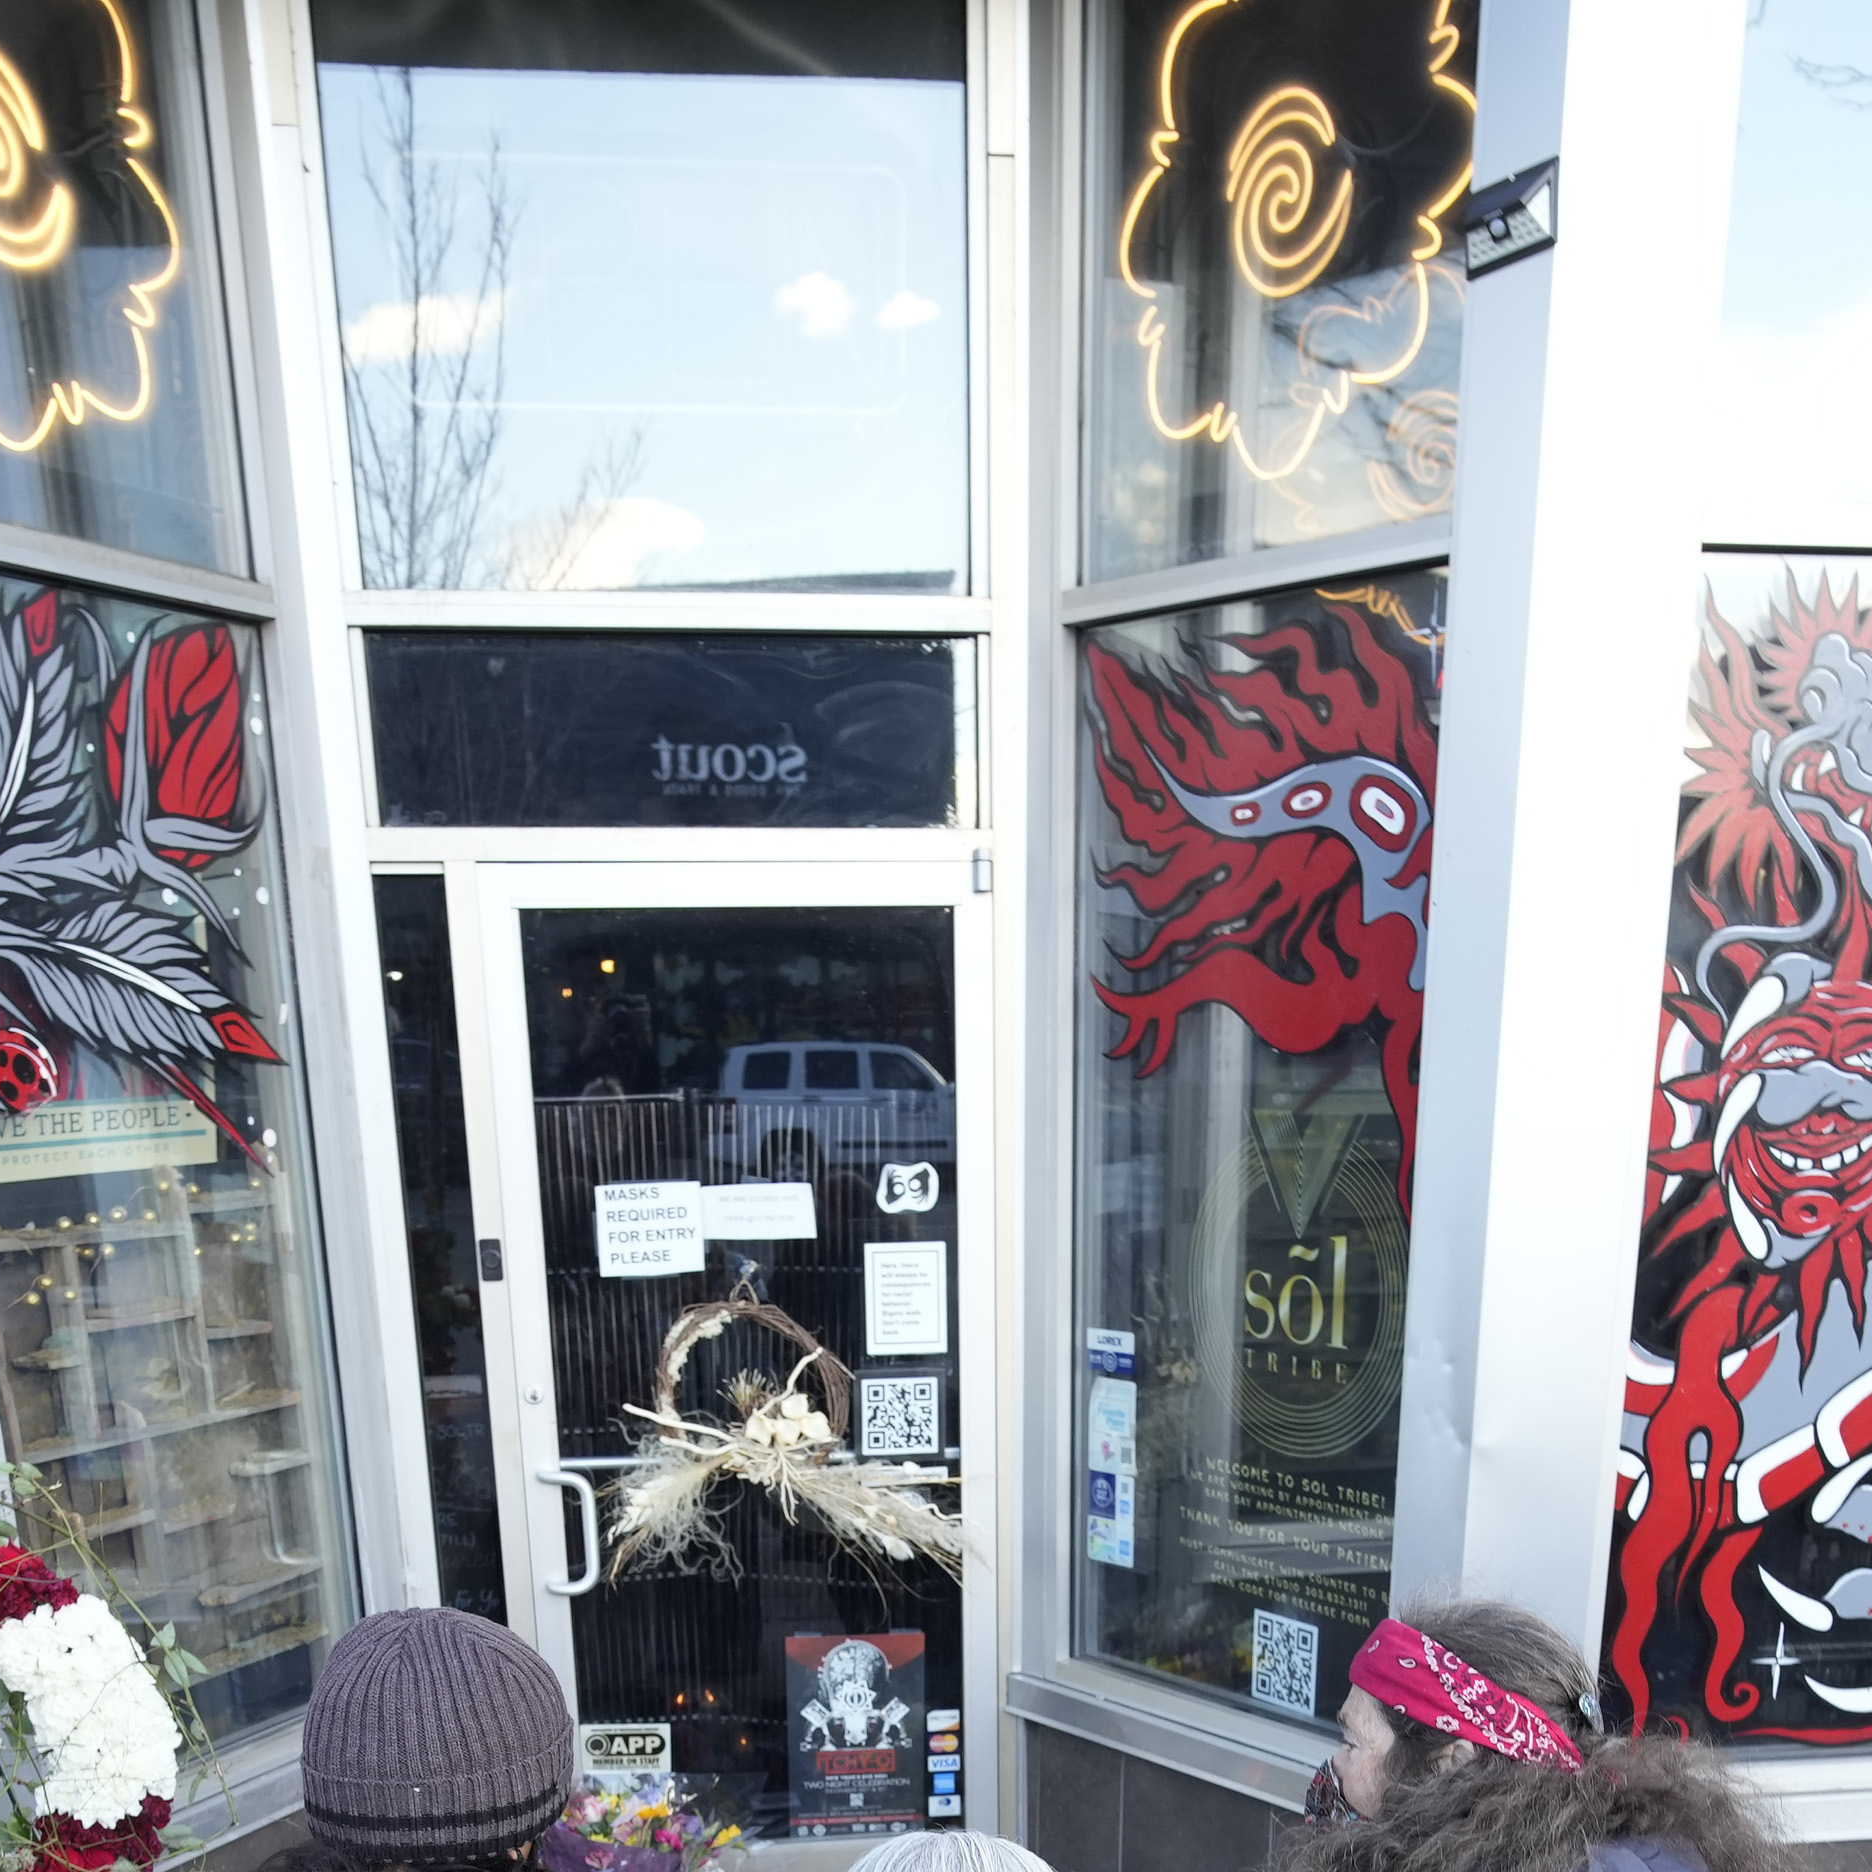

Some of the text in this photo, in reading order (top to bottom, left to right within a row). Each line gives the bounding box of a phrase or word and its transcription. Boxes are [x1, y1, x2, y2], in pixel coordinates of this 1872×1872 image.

[35, 1112, 83, 1136] THE
[92, 1106, 180, 1132] PEOPLE
[2, 1143, 170, 1166] PROTECT EACH OTHER
[605, 1187, 660, 1201] MASKS
[607, 1207, 687, 1222] REQUIRED
[609, 1227, 696, 1244] FOR ENTRY
[611, 1250, 671, 1265] PLEASE
[1244, 1348, 1347, 1385] TRIBE
[1190, 1470, 1203, 1482] WE
[1208, 1474, 1225, 1487] ARE
[1230, 1478, 1274, 1499] WORKING
[1279, 1491, 1290, 1502] BY
[1296, 1495, 1369, 1520] APPOINTMENT
[1206, 1456, 1386, 1510] WELCOME TO SOL TRIBE!
[1205, 1487, 1230, 1502] SAME
[1234, 1495, 1251, 1508] DAY
[1256, 1501, 1334, 1529] APPOINTMENTS
[1180, 1506, 1393, 1573] THANK YOU FOR YOUR PATIEN
[1179, 1536, 1203, 1551] MUST
[1208, 1544, 1276, 1571] COMMUNICATE
[1280, 1565, 1305, 1581] WITH
[1309, 1572, 1357, 1594] COUNTER
[1362, 1586, 1376, 1599] TO
[1242, 1568, 1260, 1581] THE
[1264, 1574, 1300, 1593] STUDIO
[1239, 1581, 1264, 1598] CODE
[1268, 1590, 1287, 1604] FOR
[1292, 1596, 1336, 1619] RELEASE
[1340, 1610, 1371, 1628] FORM
[932, 1758, 958, 1768] VISA
[804, 1781, 824, 1789] TWO
